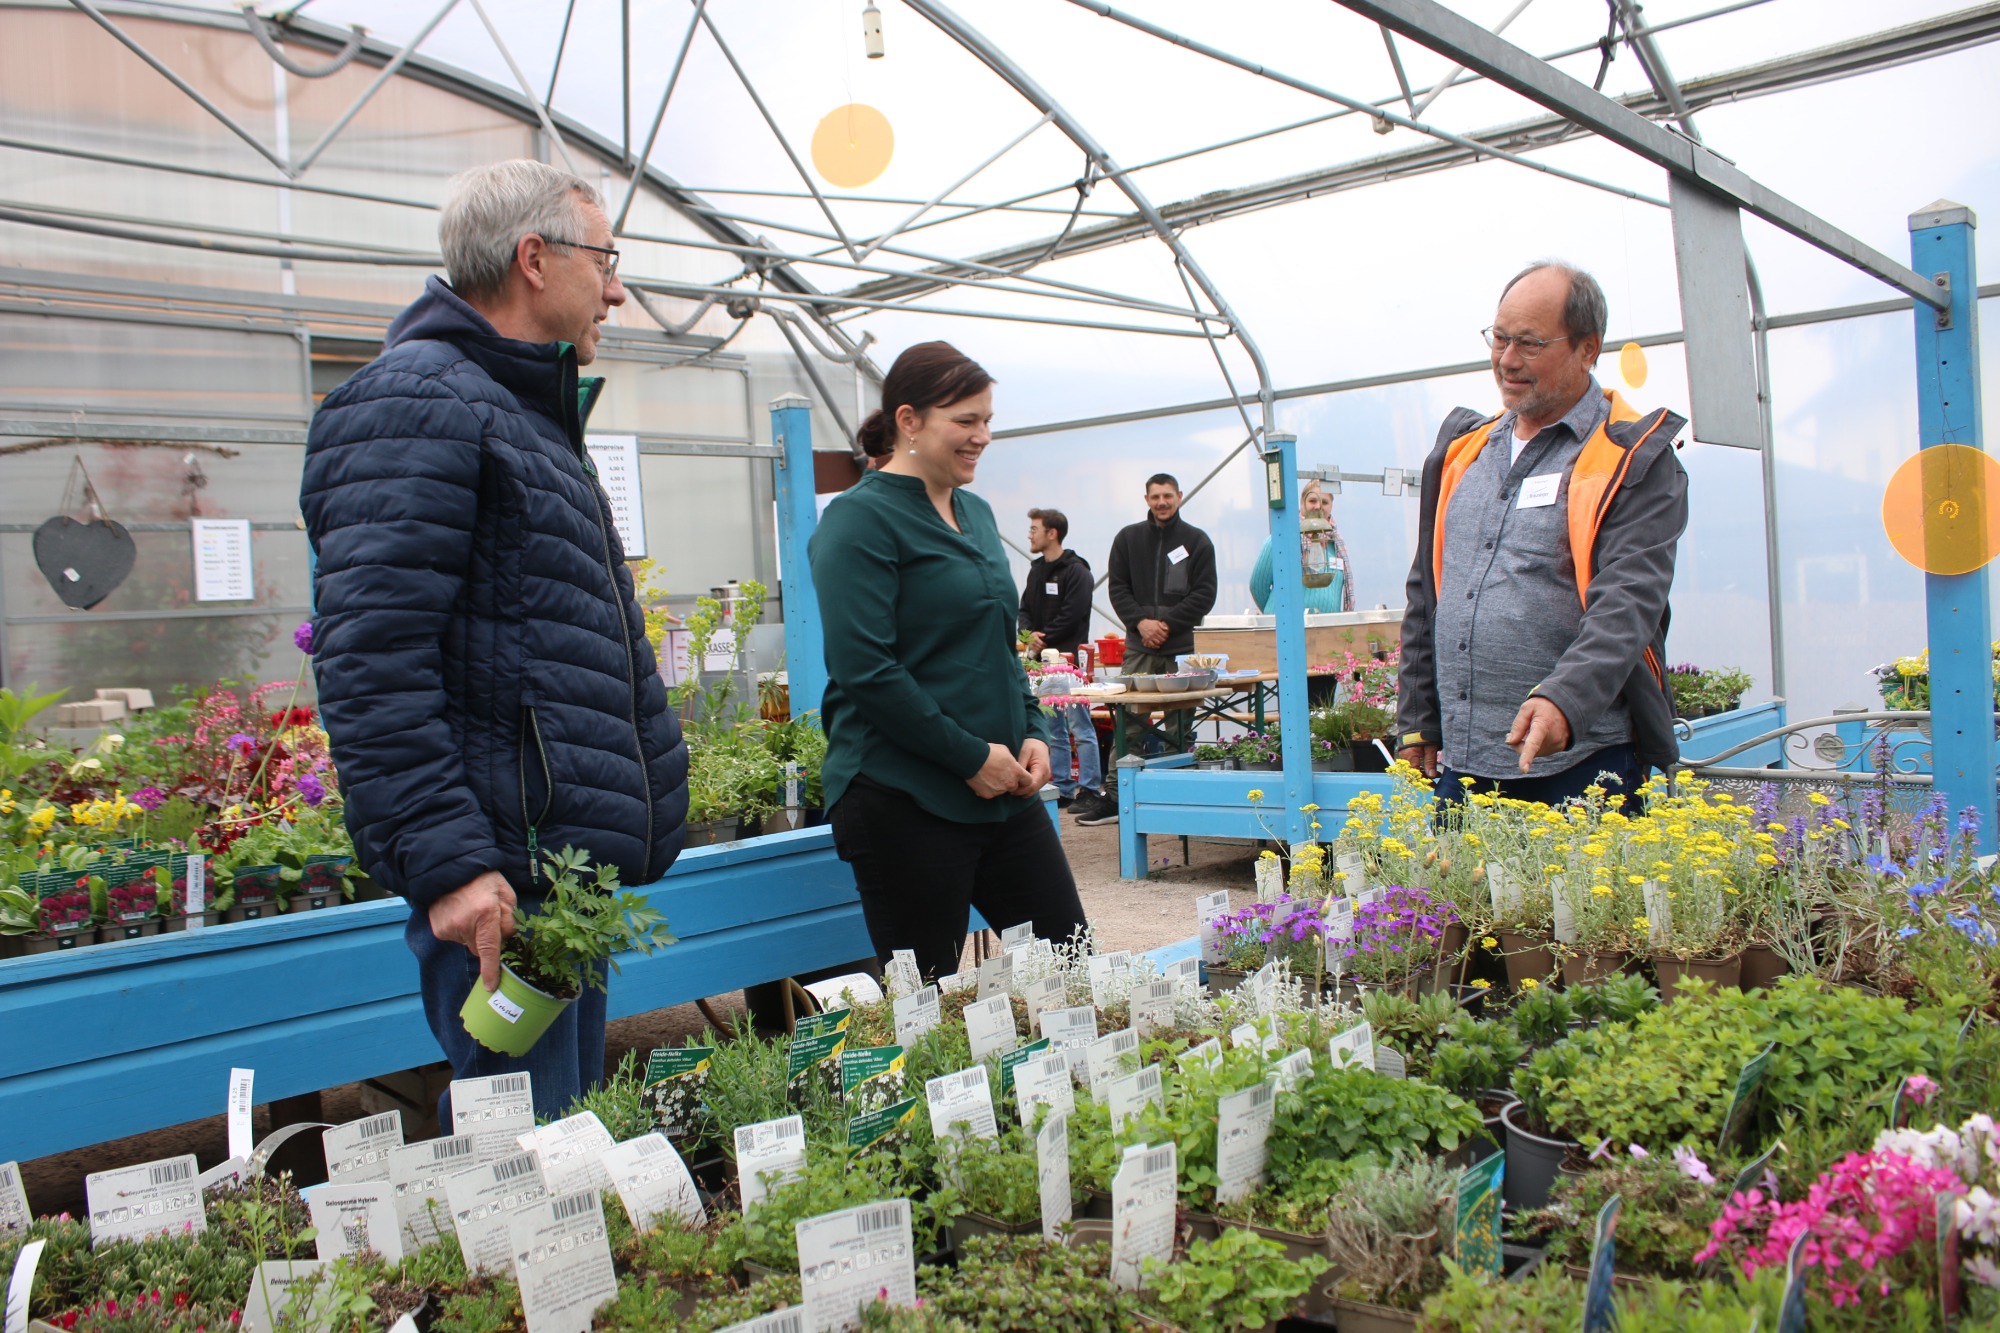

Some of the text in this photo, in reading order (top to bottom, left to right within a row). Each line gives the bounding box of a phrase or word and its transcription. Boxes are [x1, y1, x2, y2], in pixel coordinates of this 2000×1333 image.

[708, 642, 731, 653] KASSE
[842, 1050, 872, 1059] Heide-Nelke
[125, 1186, 157, 1196] Steinanlag
[326, 1199, 357, 1207] Delosperma
